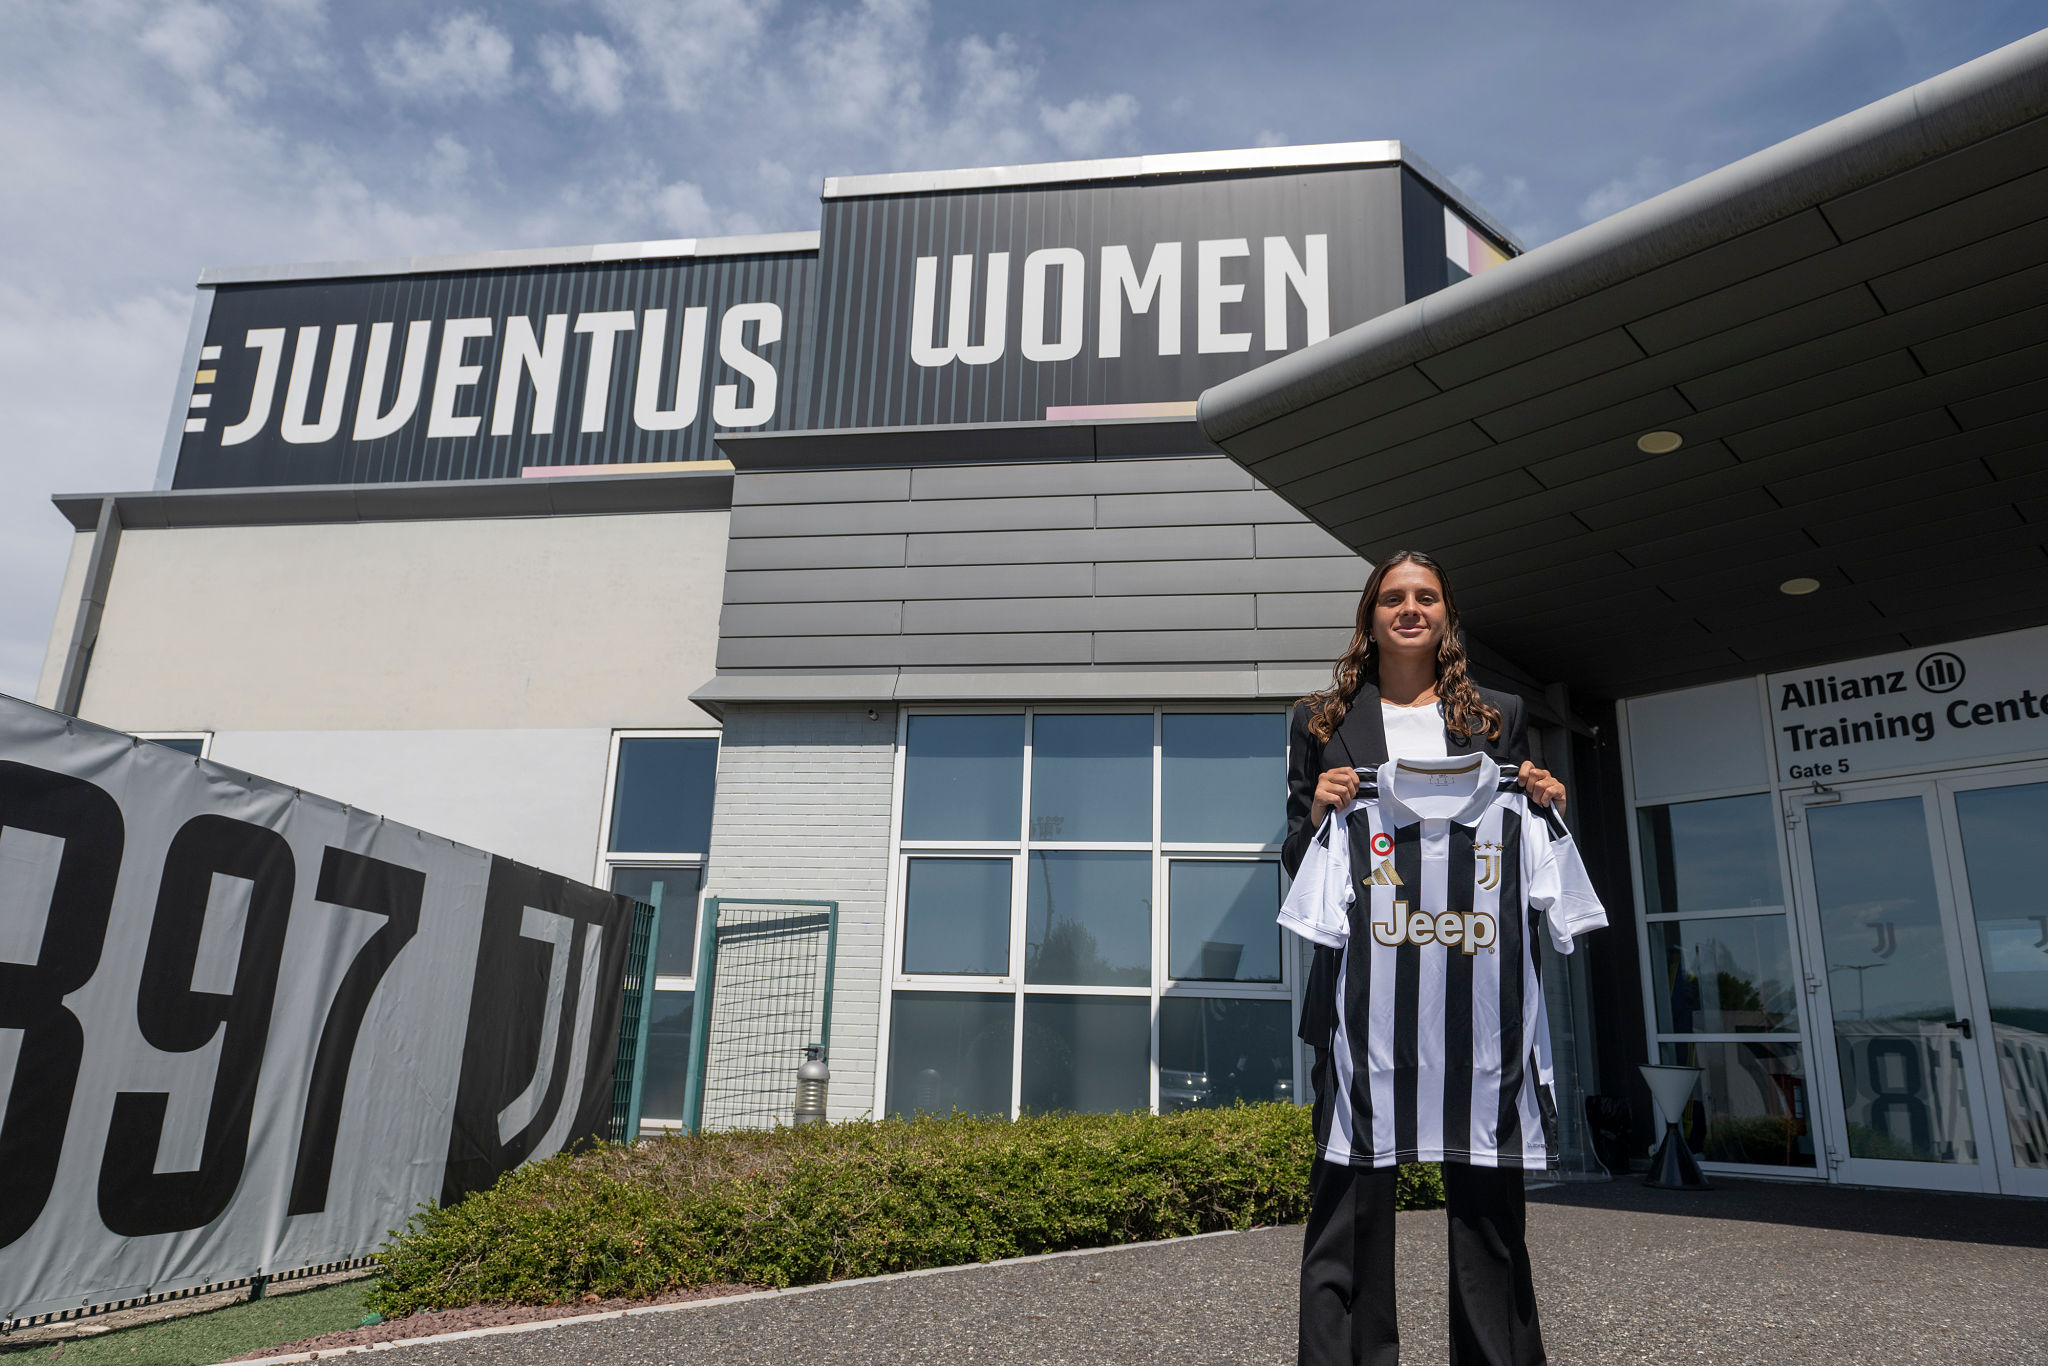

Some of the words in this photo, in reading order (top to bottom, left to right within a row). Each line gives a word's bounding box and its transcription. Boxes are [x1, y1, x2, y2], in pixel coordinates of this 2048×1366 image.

[221, 301, 783, 447] JUVENTUS
[910, 233, 1331, 367] WOMEN
[1781, 670, 1908, 710] Allianz
[1783, 709, 1936, 752] Training
[1789, 762, 1833, 780] Gate
[1838, 759, 1850, 774] 5
[1372, 900, 1497, 956] Jeep
